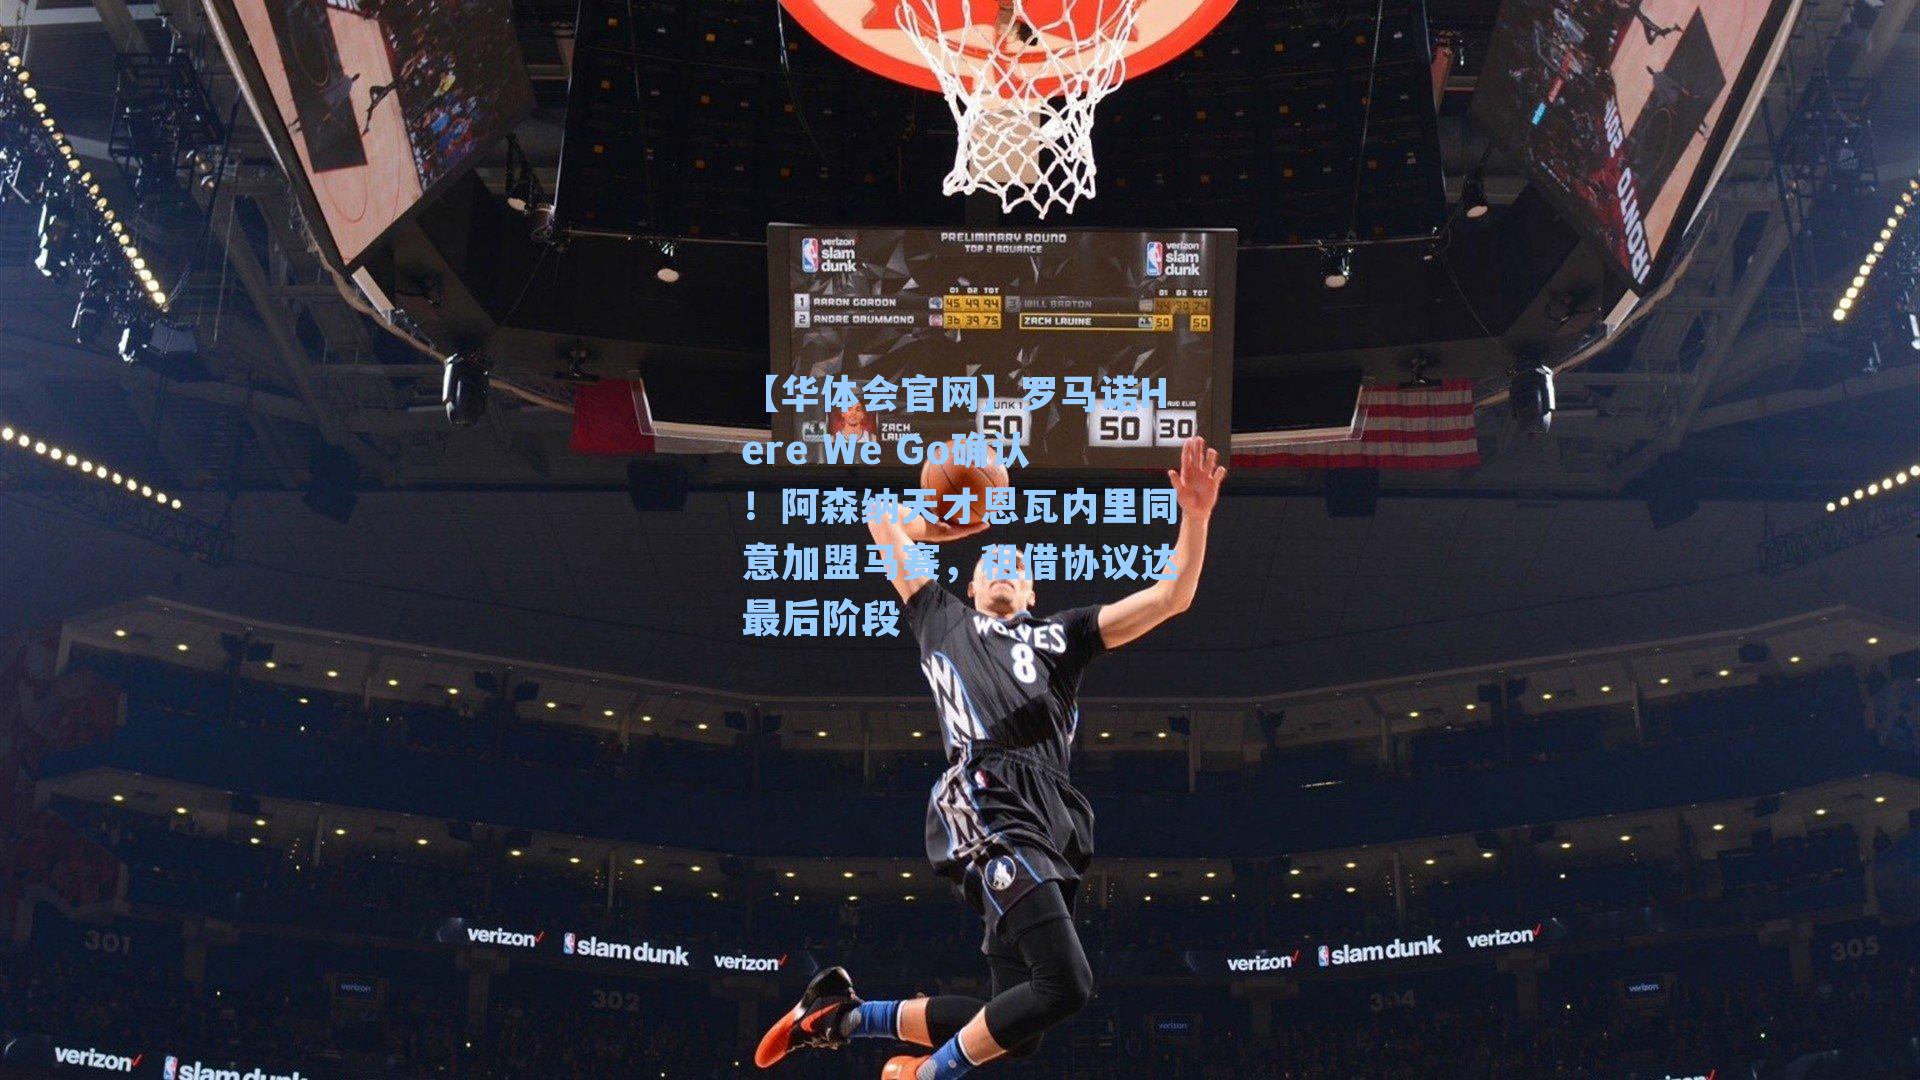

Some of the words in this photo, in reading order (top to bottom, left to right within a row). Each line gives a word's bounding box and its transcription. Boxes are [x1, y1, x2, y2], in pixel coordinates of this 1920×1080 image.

[821, 238, 854, 246] verizon
[940, 232, 1022, 242] PRELIMINARY
[1025, 233, 1067, 243] ROUND
[964, 244, 984, 253] TOP
[986, 245, 993, 253] 2
[995, 245, 1042, 253] ADVANCE
[1166, 242, 1199, 250] verizon
[821, 247, 855, 259] slam
[1165, 250, 1199, 263] slam
[821, 261, 857, 272] dunk
[1165, 264, 1200, 276] dunk
[813, 298, 850, 307] AARON
[853, 298, 896, 307] GORDON
[946, 299, 960, 308] 45
[965, 299, 980, 308] 49
[983, 299, 999, 308] 94
[1024, 299, 1047, 308] WILL
[1050, 299, 1092, 308] BARTON
[798, 315, 806, 324] 2
[813, 315, 849, 324] ANDRE
[852, 315, 914, 324] DRUMMOND
[965, 316, 980, 325] 39
[984, 316, 999, 325] 75
[1024, 316, 1052, 325] ZACH
[1055, 317, 1092, 326] LAVINE
[1156, 318, 1170, 327] 50
[1193, 318, 1208, 327] 50
[990, 401, 1015, 410] UNK
[881, 423, 911, 432] ZACH
[983, 416, 1023, 440] 50
[1101, 416, 1140, 441] 50
[1159, 418, 1193, 438] 30
[1011, 643, 1037, 684] 8
[84, 930, 131, 954] 301
[467, 927, 536, 948] verizon
[1467, 928, 1534, 948] verizon
[577, 936, 632, 960] slam
[633, 942, 690, 967] dunk
[1331, 944, 1384, 965] slam
[1386, 935, 1442, 959] dunk
[1830, 935, 1880, 960] 305
[714, 954, 779, 971] verizon
[1227, 953, 1292, 971] verizon
[340, 982, 371, 993] verizon
[1628, 983, 1660, 993] verizon
[591, 989, 640, 1013] 302
[55, 1046, 132, 1072] verizon
